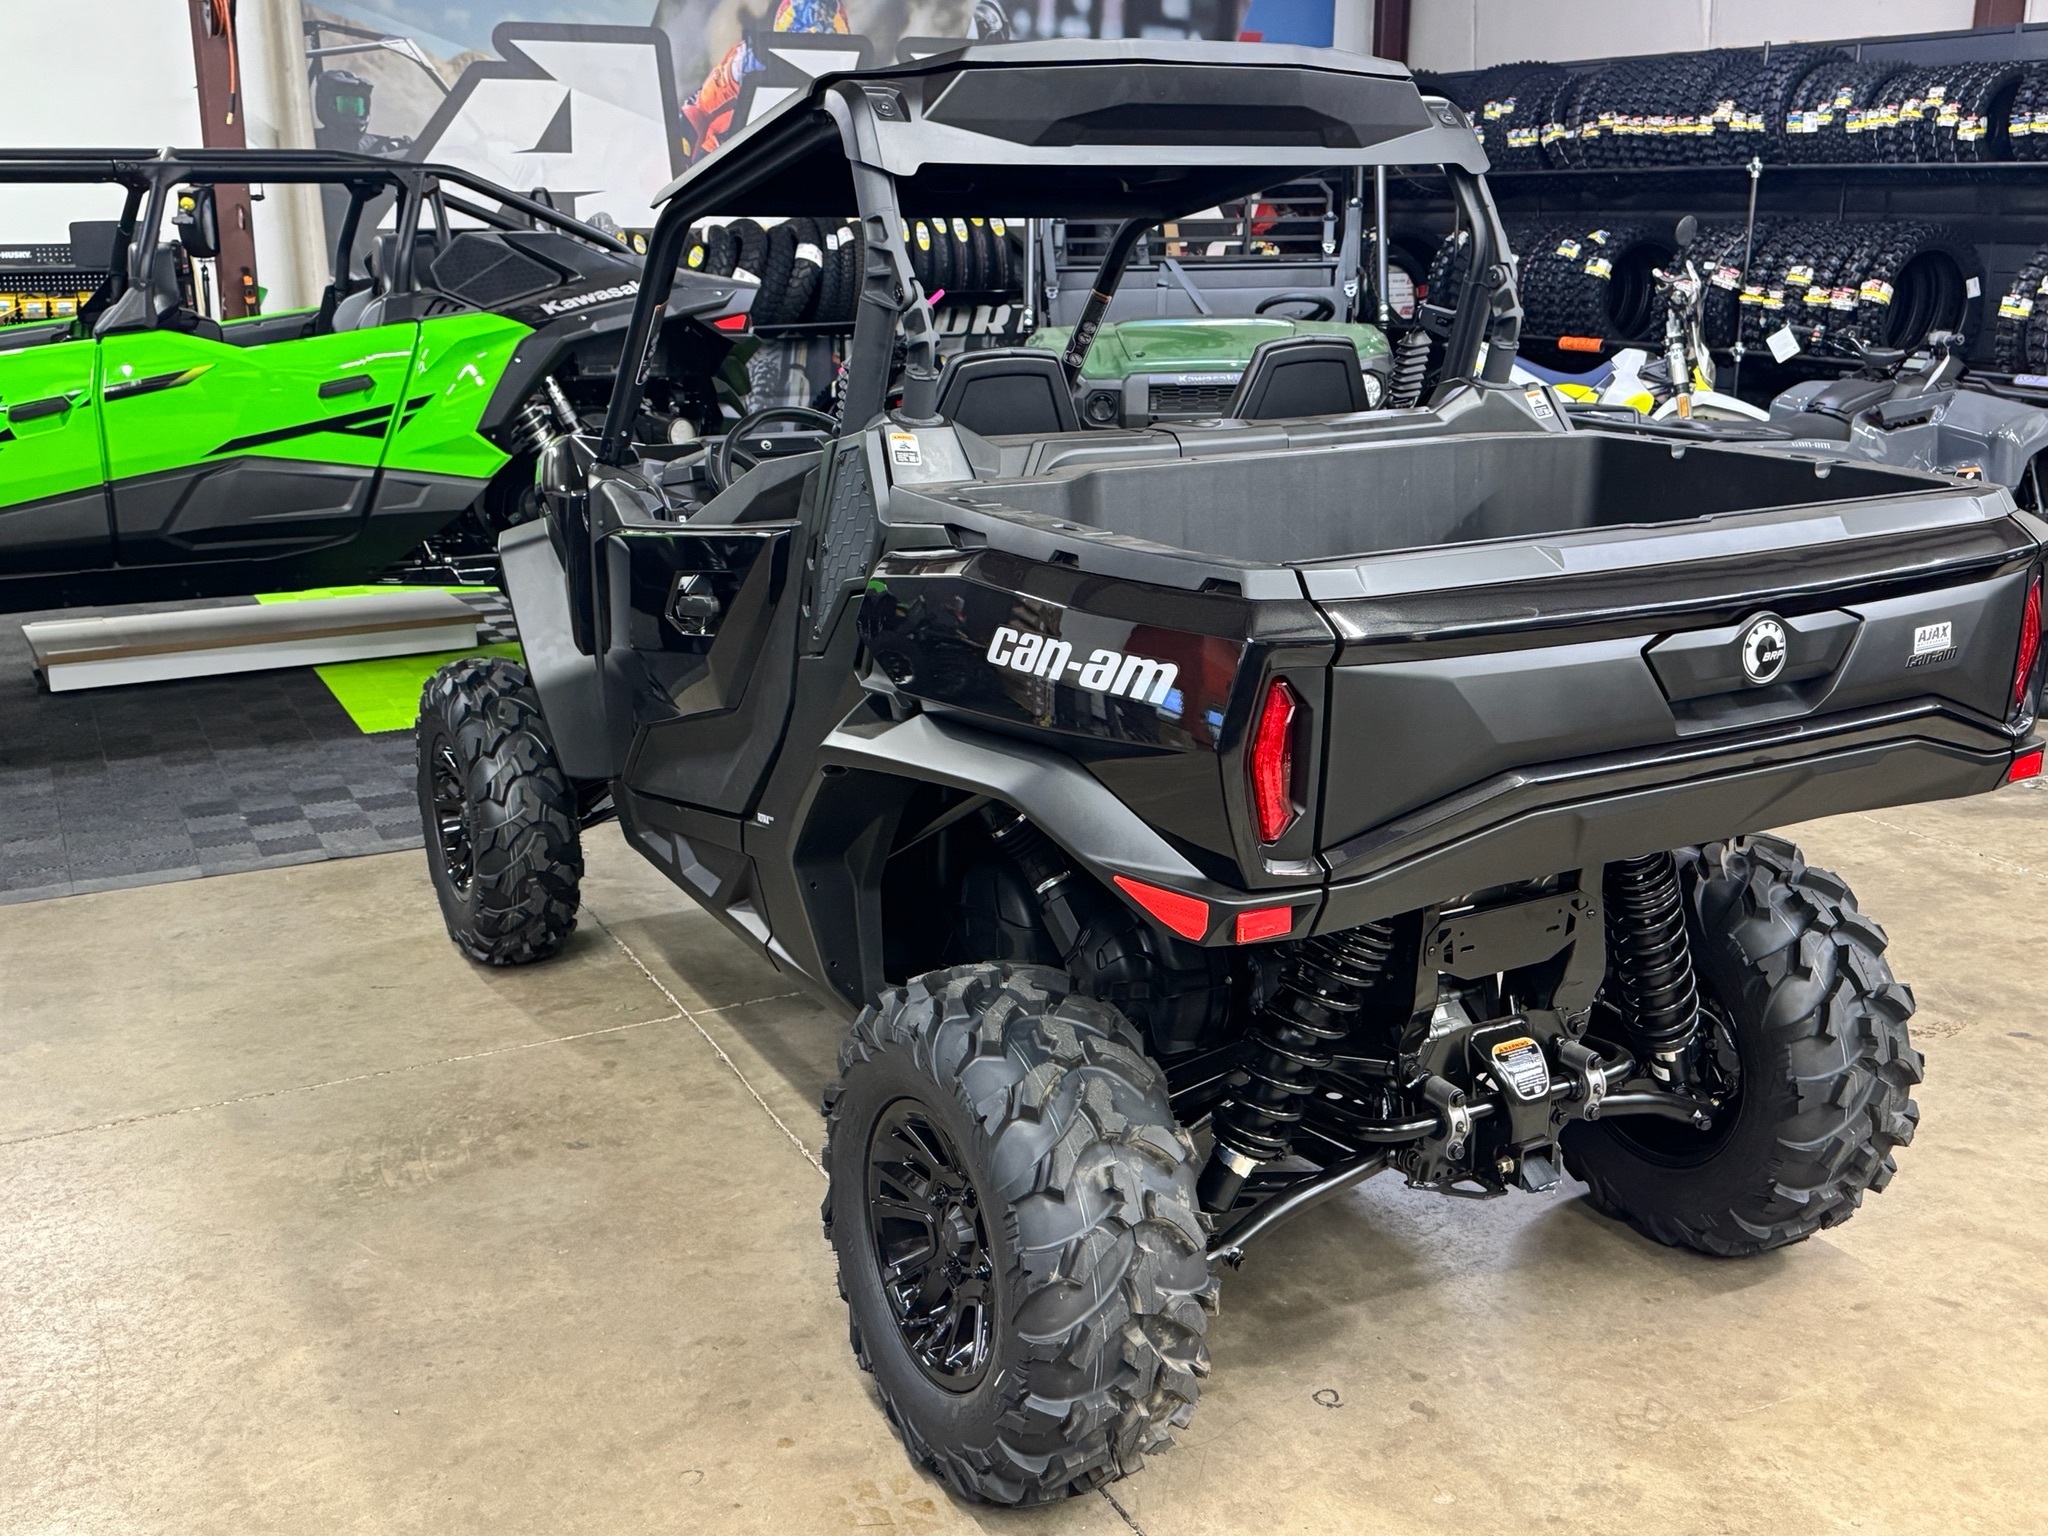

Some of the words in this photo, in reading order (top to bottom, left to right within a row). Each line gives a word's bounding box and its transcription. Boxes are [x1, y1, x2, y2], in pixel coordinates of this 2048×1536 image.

[540, 280, 640, 315] Kawasak
[986, 626, 1180, 705] can-am
[1762, 649, 1784, 662] BRP
